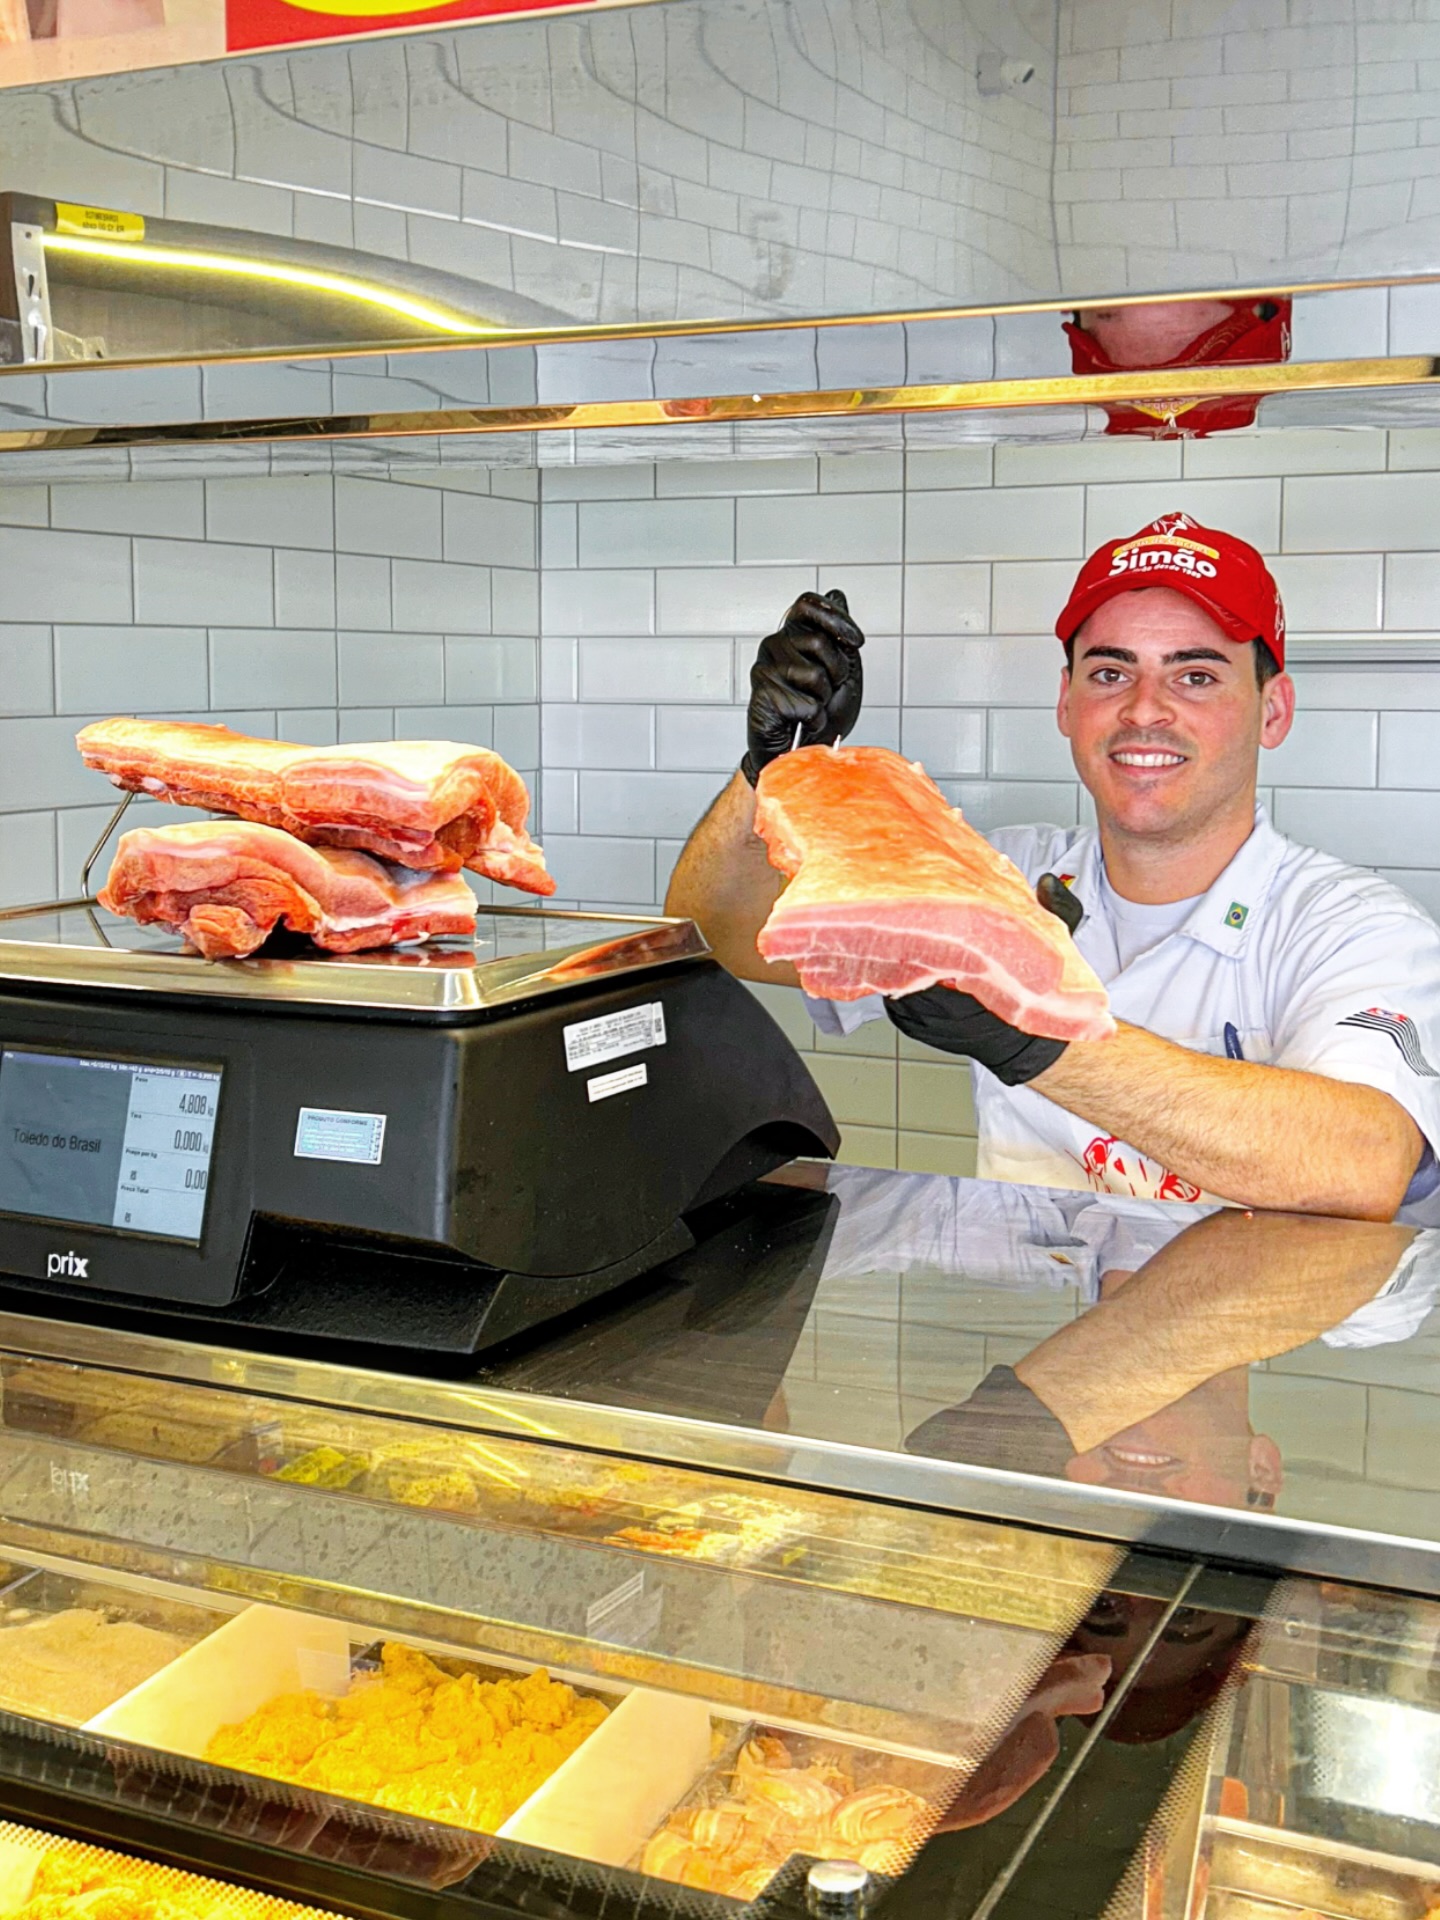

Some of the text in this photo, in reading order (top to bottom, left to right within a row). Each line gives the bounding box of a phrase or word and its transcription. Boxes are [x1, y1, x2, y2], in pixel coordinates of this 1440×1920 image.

[1108, 547, 1217, 578] Simão
[13, 1128, 101, 1153] Toledo do Brasil
[47, 1251, 89, 1278] prix
